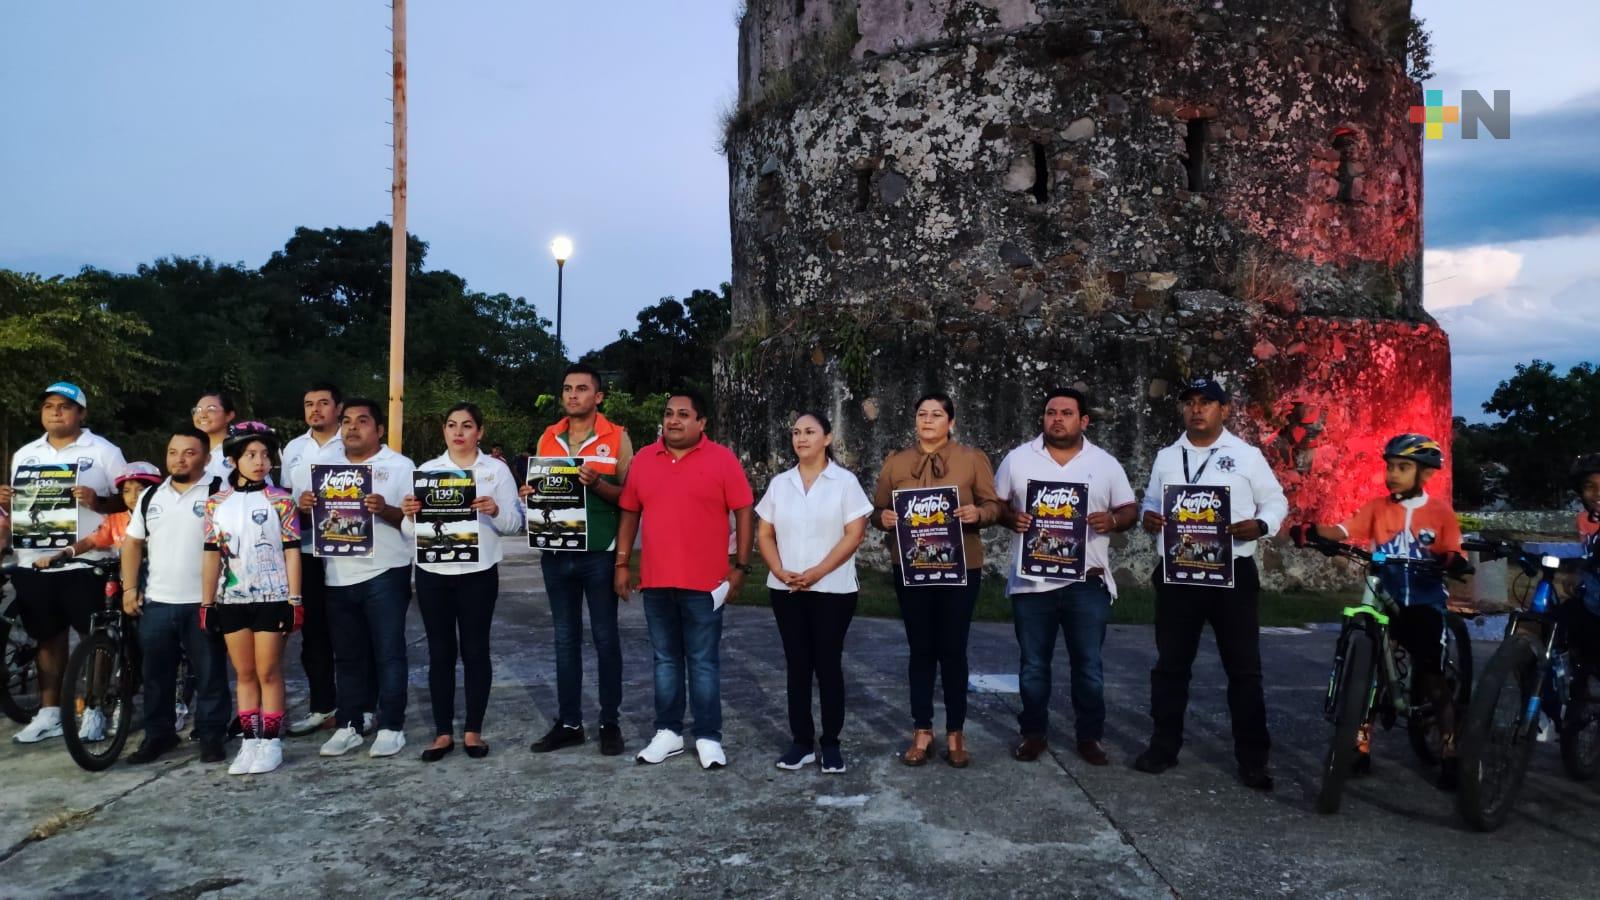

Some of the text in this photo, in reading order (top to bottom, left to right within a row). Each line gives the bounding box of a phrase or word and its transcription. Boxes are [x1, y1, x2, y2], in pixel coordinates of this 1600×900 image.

[319, 469, 364, 493] Xantolo
[546, 476, 563, 487] 139
[435, 489, 454, 500] 139
[904, 493, 950, 519] Xantolo
[1032, 486, 1079, 510] Xantolo
[1171, 490, 1221, 514] Xantolo
